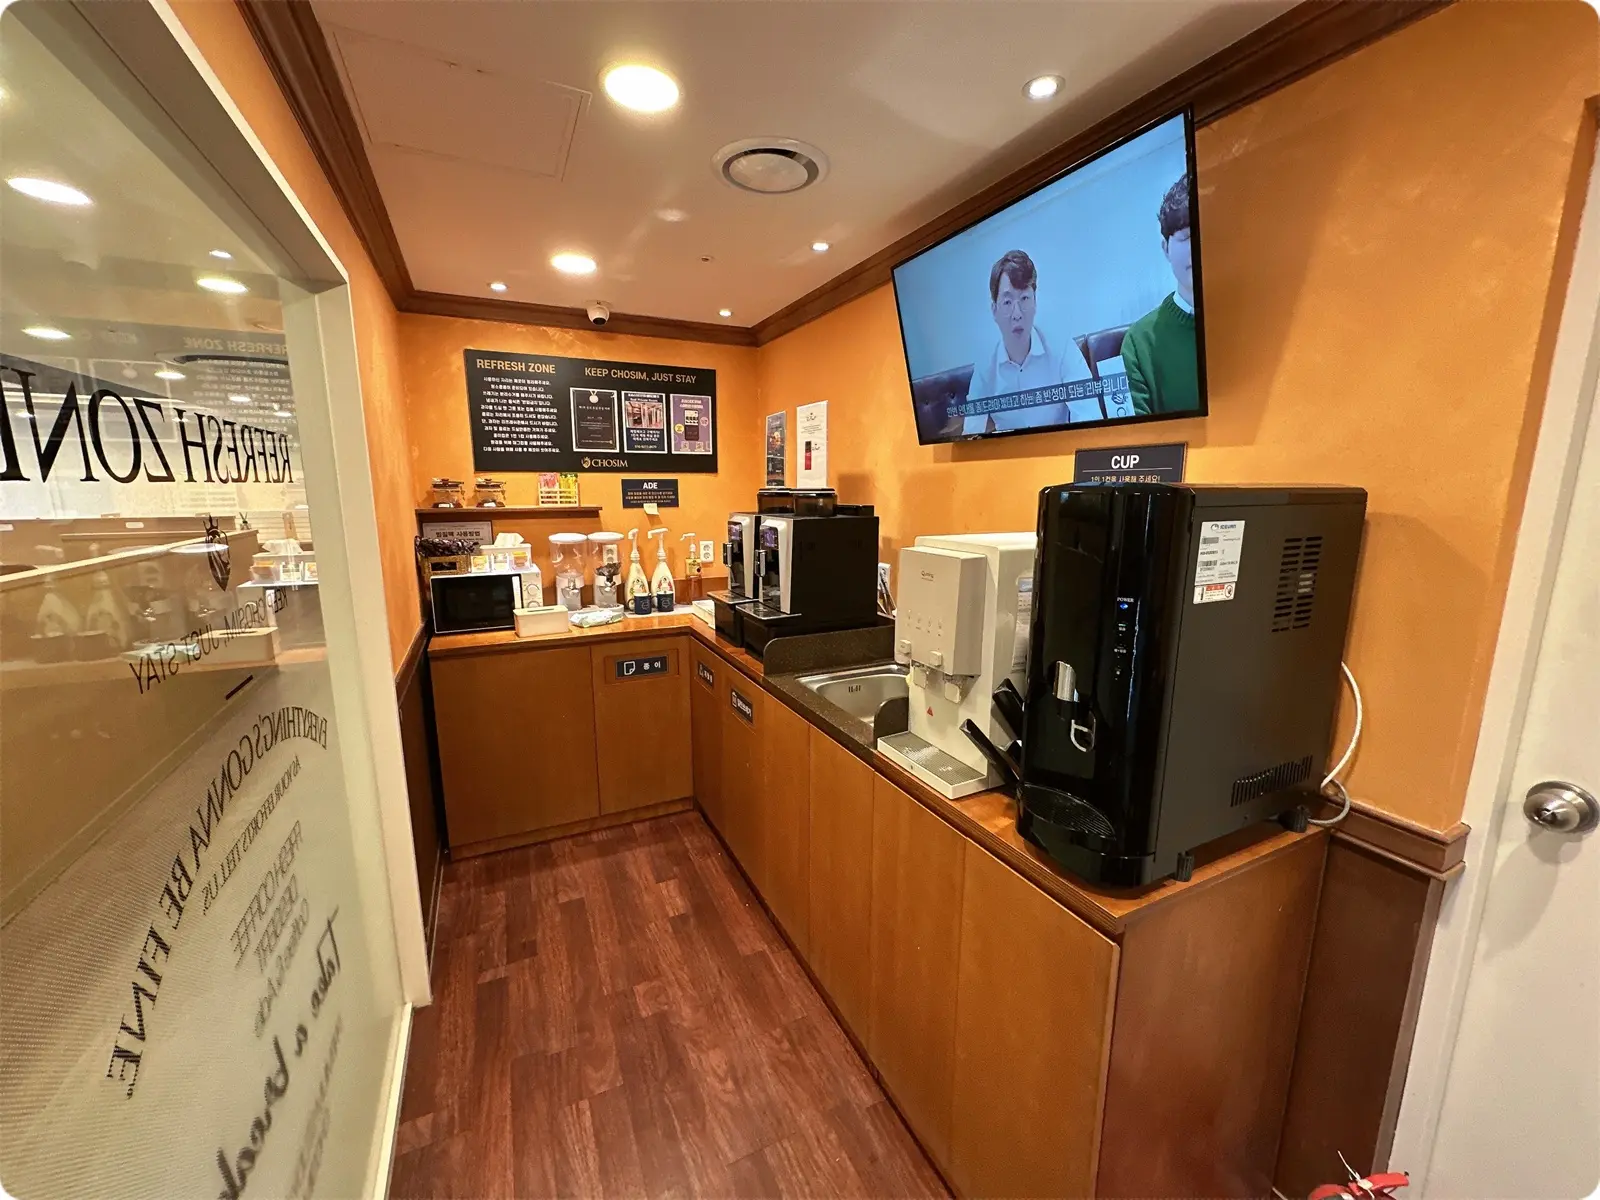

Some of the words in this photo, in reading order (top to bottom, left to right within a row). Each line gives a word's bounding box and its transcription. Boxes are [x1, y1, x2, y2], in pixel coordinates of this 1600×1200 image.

[476, 359, 526, 372] REFRESH
[528, 363, 556, 374] ZONE
[585, 367, 609, 377] KEEP
[611, 369, 649, 381] CHOSIM,
[651, 372, 674, 383] JUST
[676, 374, 697, 384] STAY
[592, 458, 628, 468] CHOSIM
[1111, 454, 1140, 469] CUP
